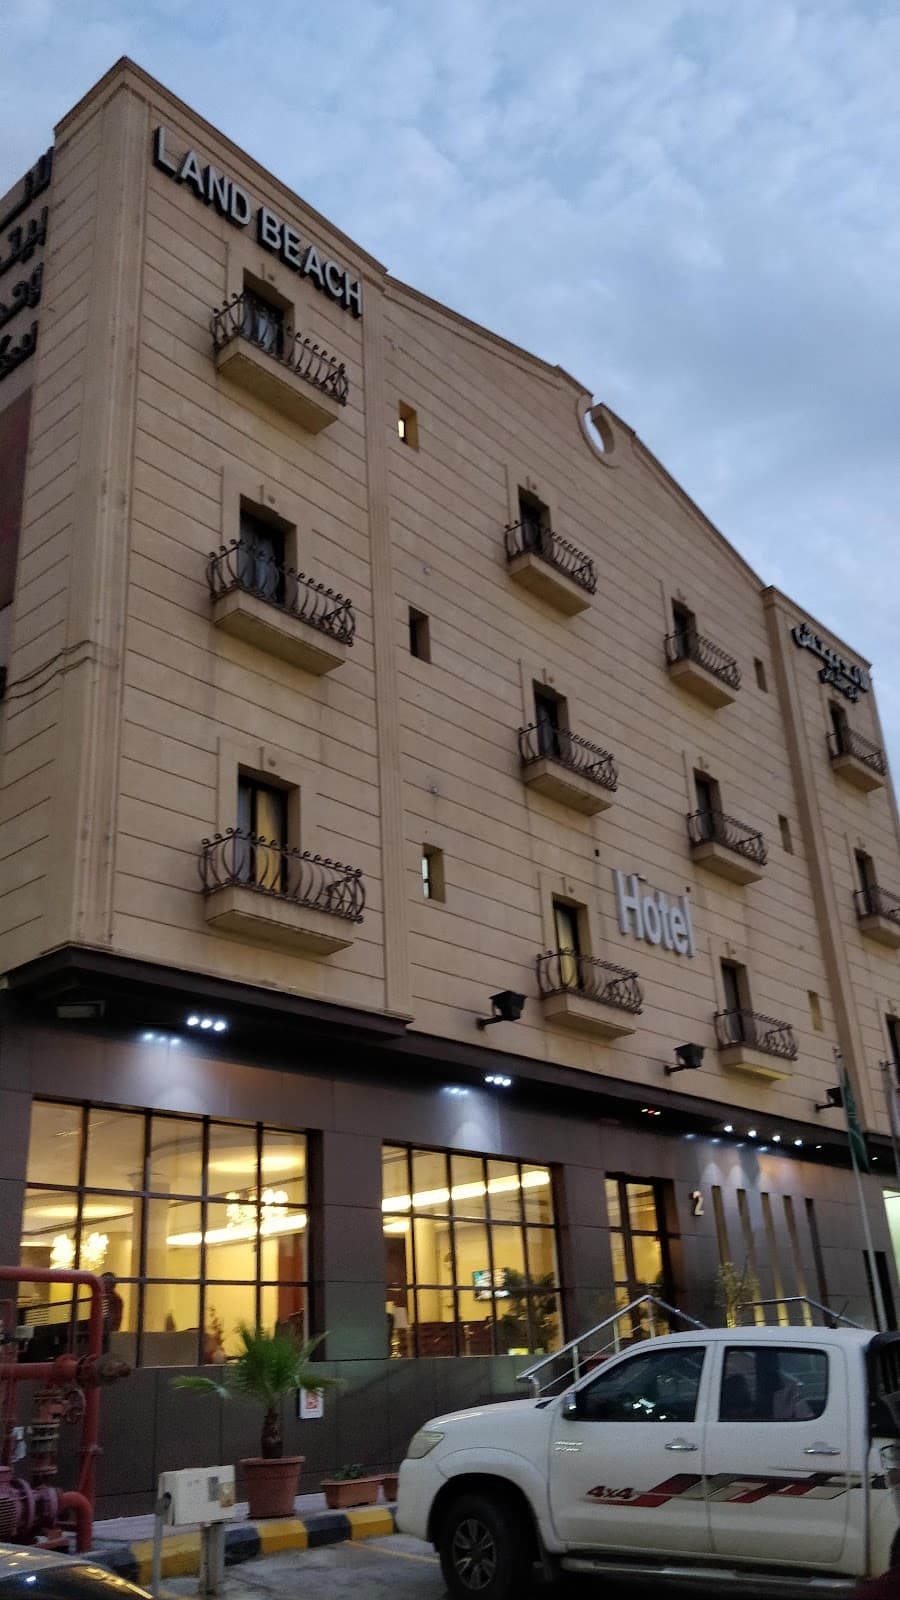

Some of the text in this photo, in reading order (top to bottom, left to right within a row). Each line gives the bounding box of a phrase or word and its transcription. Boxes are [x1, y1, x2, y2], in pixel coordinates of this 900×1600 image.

[155, 127, 250, 228] LAND
[257, 206, 363, 317] BEACH
[614, 868, 696, 957] Hotel
[691, 1189, 705, 1216] 2
